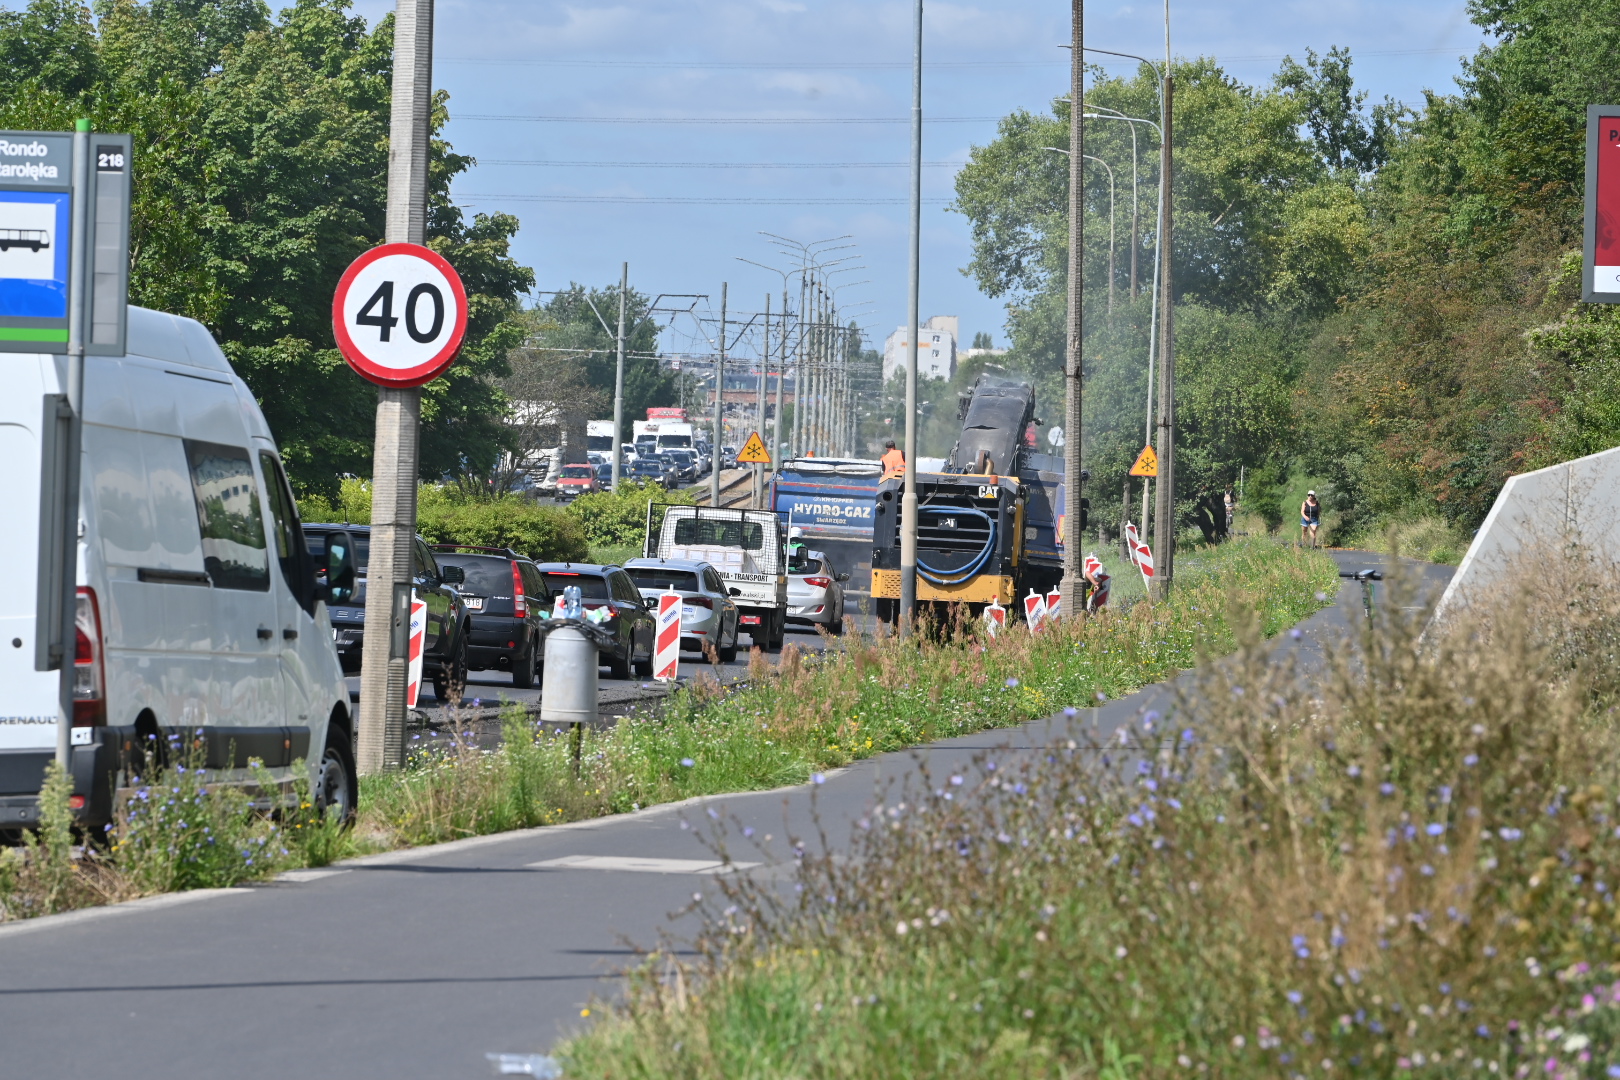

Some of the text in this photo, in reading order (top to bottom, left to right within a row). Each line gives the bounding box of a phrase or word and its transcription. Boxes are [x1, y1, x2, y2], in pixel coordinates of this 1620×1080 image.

[0, 140, 48, 157] Rondo
[98, 153, 124, 167] 218
[0, 162, 58, 181] arołęka
[356, 280, 445, 344] 40
[978, 485, 999, 498] CAT
[794, 503, 871, 519] HYDRO-GAZ
[940, 518, 955, 527] AT
[734, 573, 768, 582] TRANSPORT
